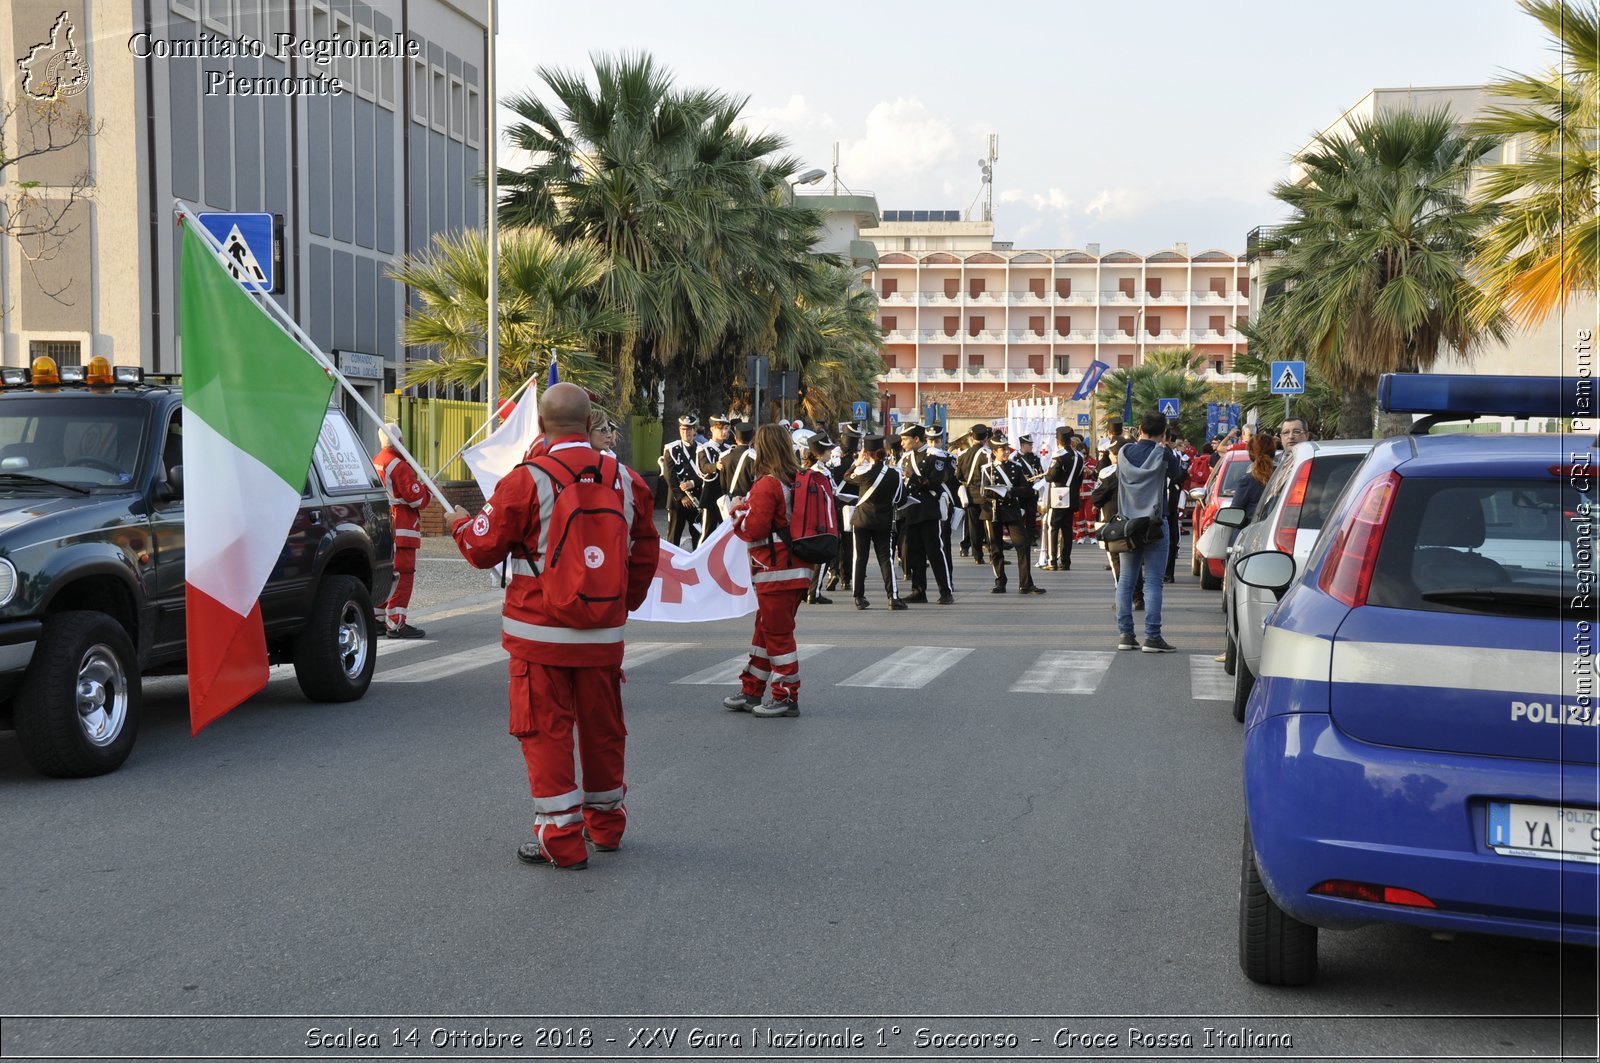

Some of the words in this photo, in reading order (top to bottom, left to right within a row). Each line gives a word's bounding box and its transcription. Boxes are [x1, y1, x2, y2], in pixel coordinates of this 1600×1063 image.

[351, 353, 373, 365] COMANDO
[345, 365, 361, 376] POLIZIA
[362, 367, 378, 377] LOCALE
[1525, 820, 1553, 847] YA
